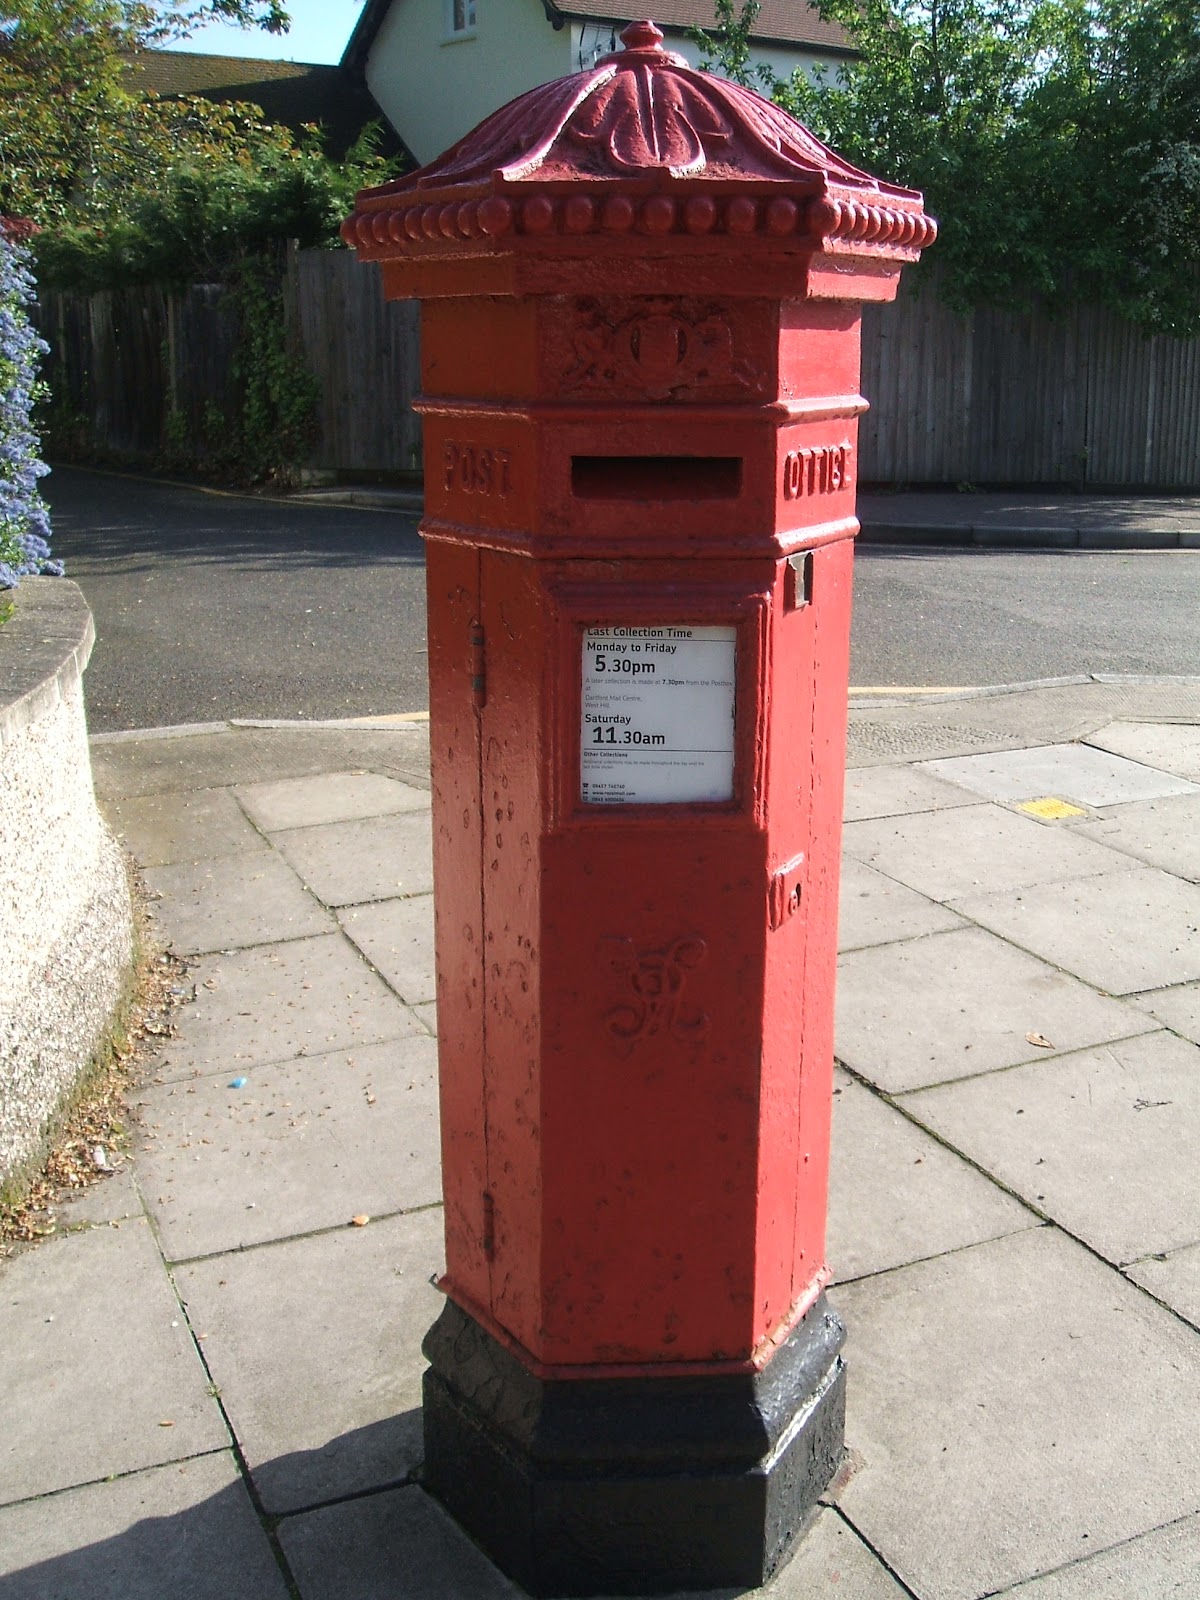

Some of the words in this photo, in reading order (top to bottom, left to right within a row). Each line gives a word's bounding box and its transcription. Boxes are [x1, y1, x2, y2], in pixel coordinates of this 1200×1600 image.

[443, 445, 512, 499] POST
[614, 628, 663, 637] Collection
[667, 628, 692, 638] Time
[588, 642, 628, 654] Monday
[631, 644, 640, 652] to
[646, 643, 677, 654] Friday
[595, 655, 656, 675] 5.30pm
[585, 714, 631, 725] Saturday
[593, 726, 665, 744] 11.30am
